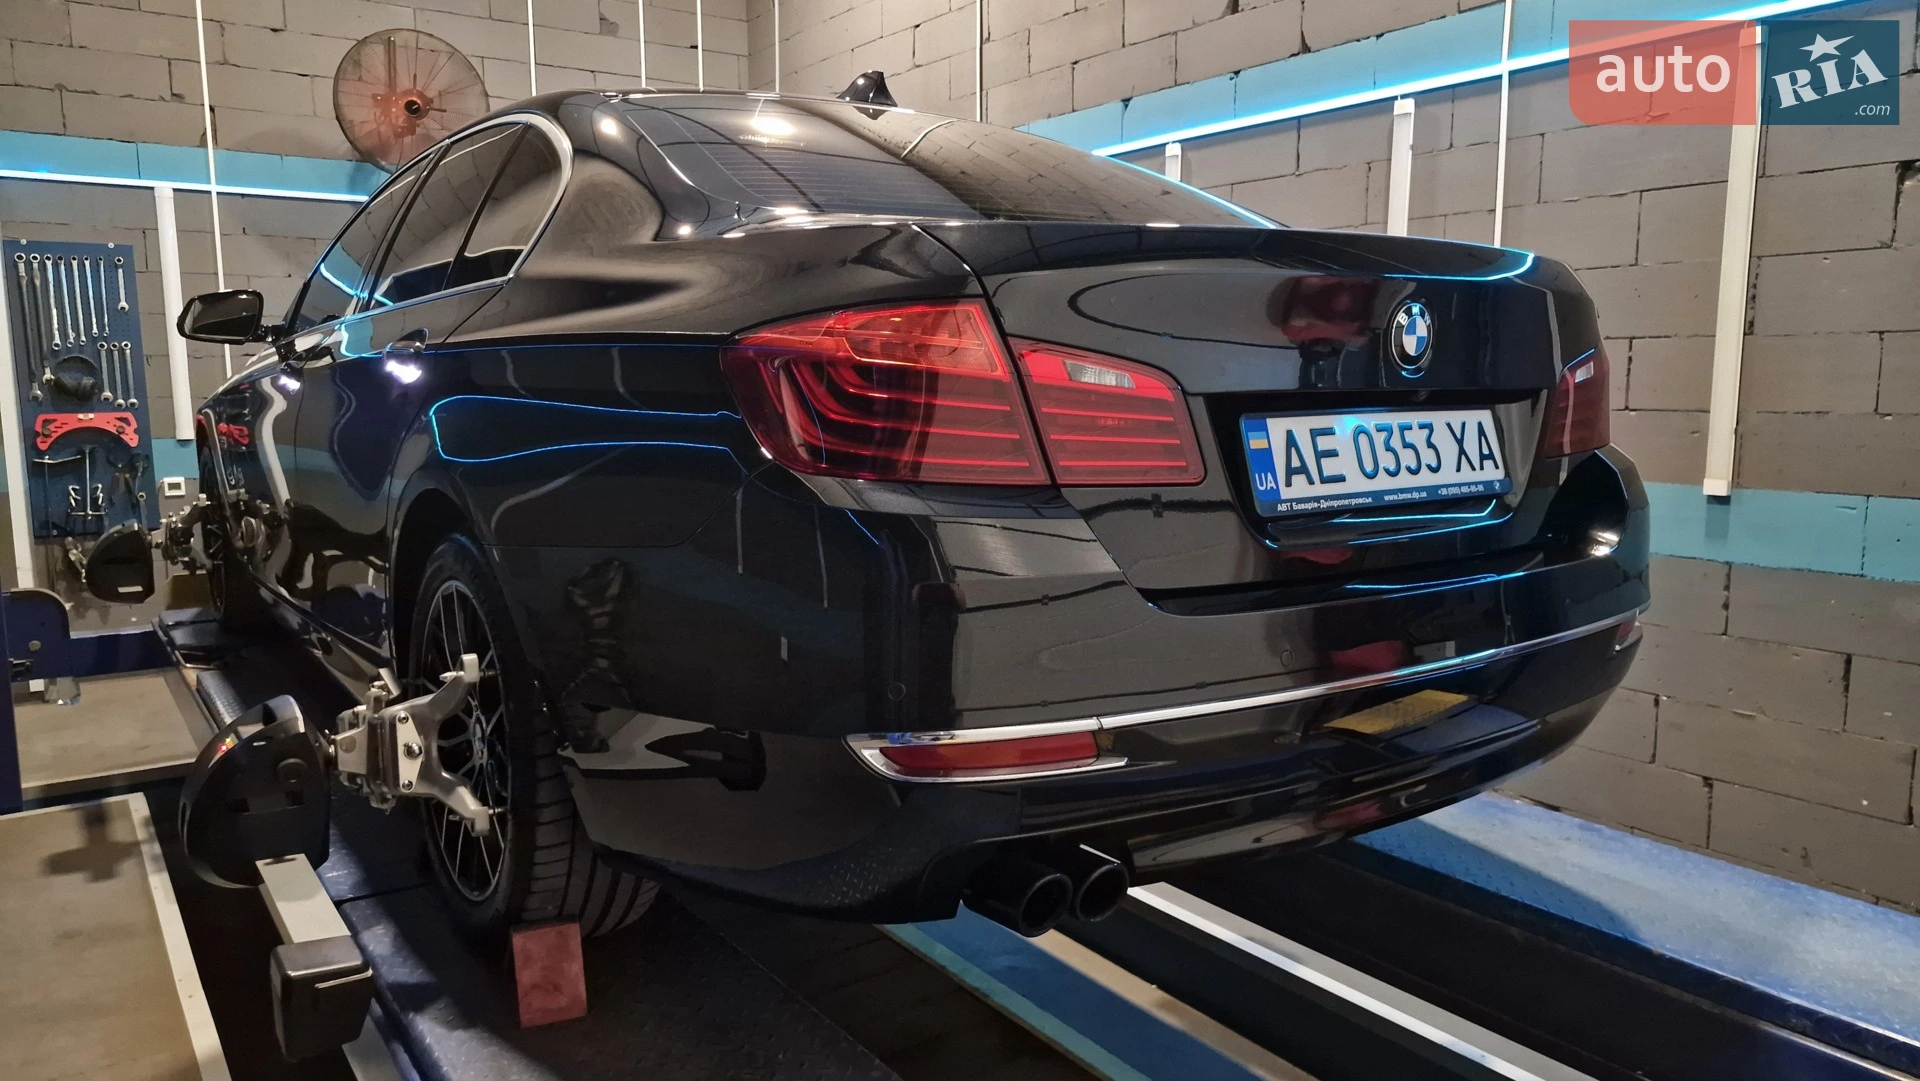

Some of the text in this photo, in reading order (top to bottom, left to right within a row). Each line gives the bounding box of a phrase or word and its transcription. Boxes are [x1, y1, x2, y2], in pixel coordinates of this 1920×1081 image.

[1284, 420, 1500, 488] AE 0353 XA
[1254, 471, 1277, 491] UA
